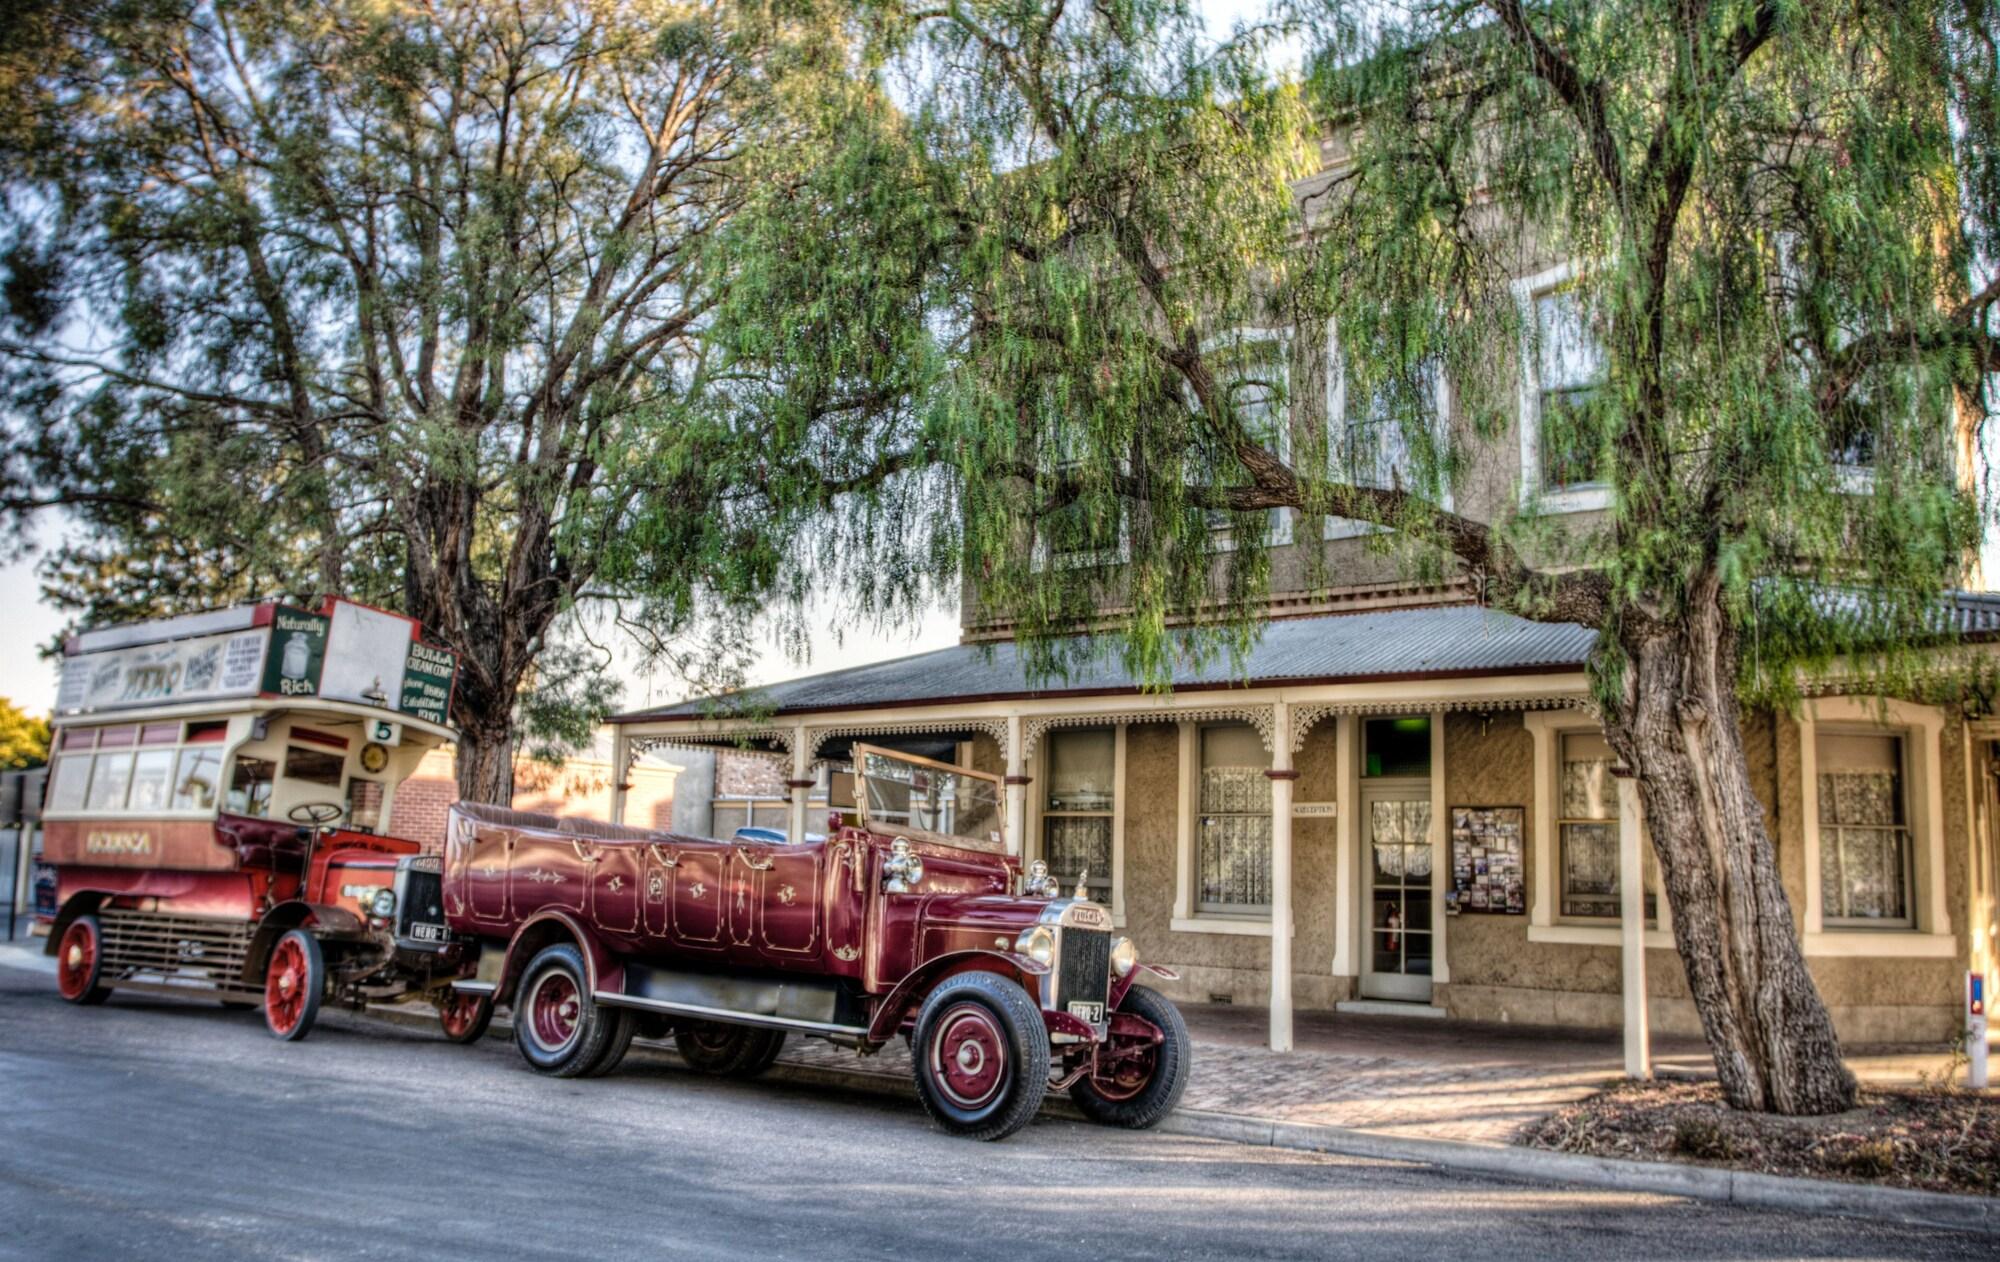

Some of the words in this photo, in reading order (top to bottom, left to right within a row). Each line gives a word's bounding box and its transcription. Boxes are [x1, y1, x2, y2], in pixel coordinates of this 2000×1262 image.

[276, 615, 325, 637] Naturally
[412, 644, 453, 666] BULLA
[406, 656, 433, 676] CREAM
[280, 678, 314, 695] Rich
[376, 721, 392, 740] 5
[1074, 909, 1102, 924] VULCAN
